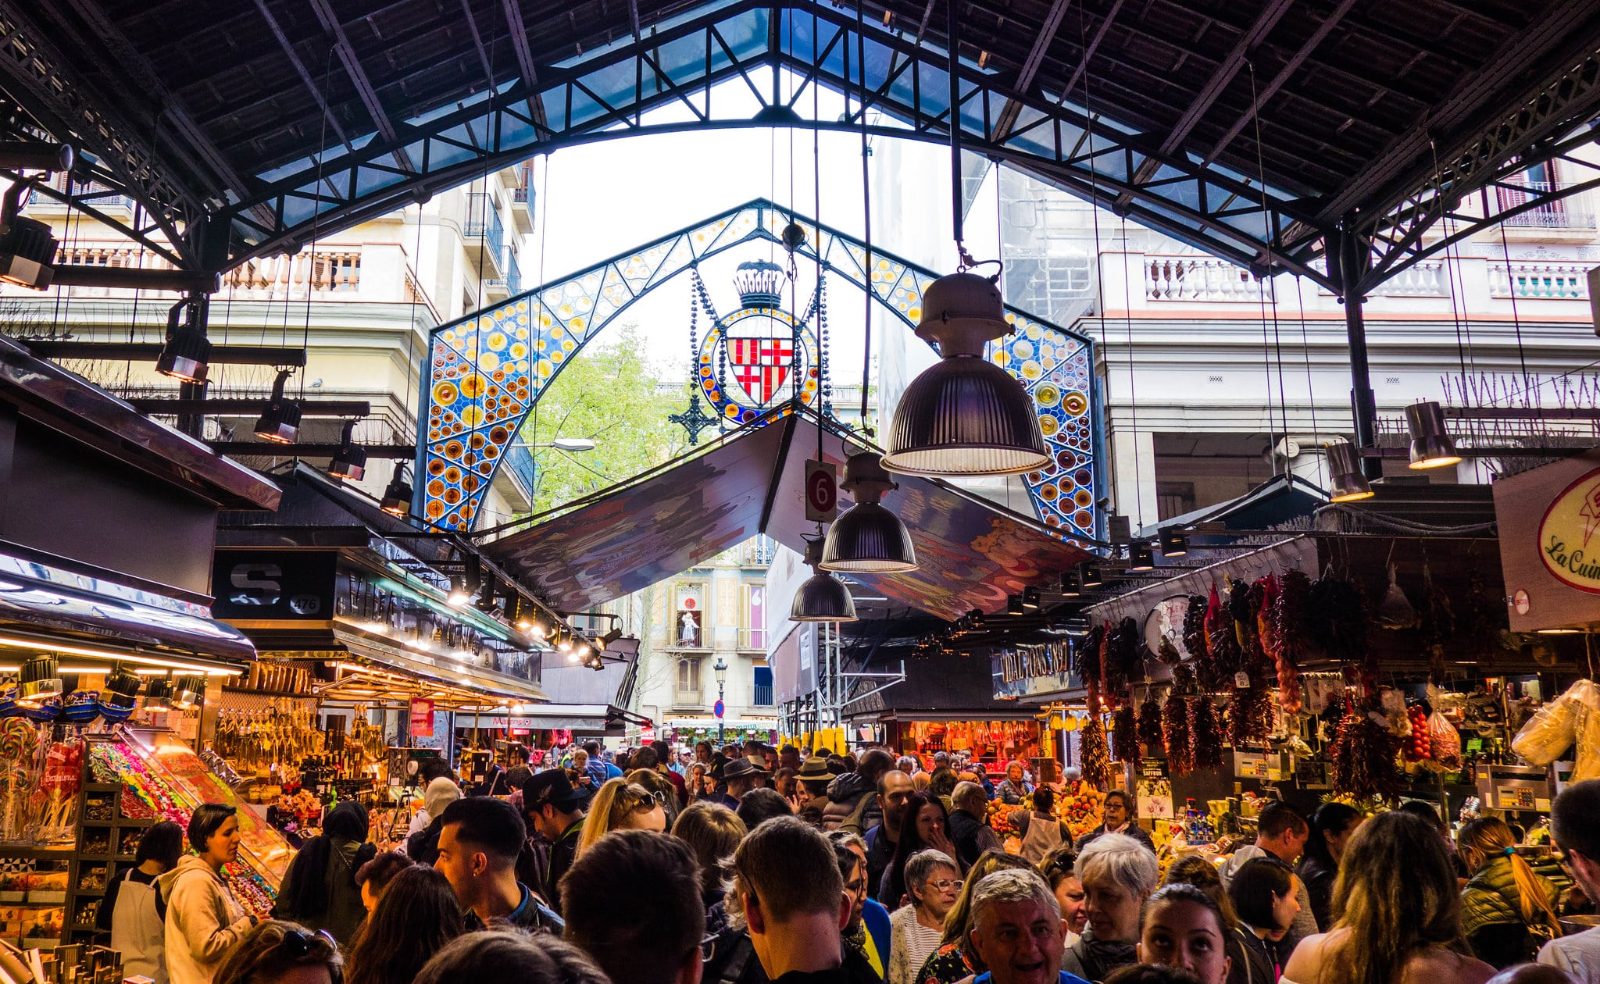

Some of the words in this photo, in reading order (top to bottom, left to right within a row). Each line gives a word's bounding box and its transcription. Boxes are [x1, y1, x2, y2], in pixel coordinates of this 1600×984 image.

[816, 478, 828, 505] 6
[1545, 535, 1568, 567] La
[230, 564, 281, 605] S
[294, 599, 316, 610] 476
